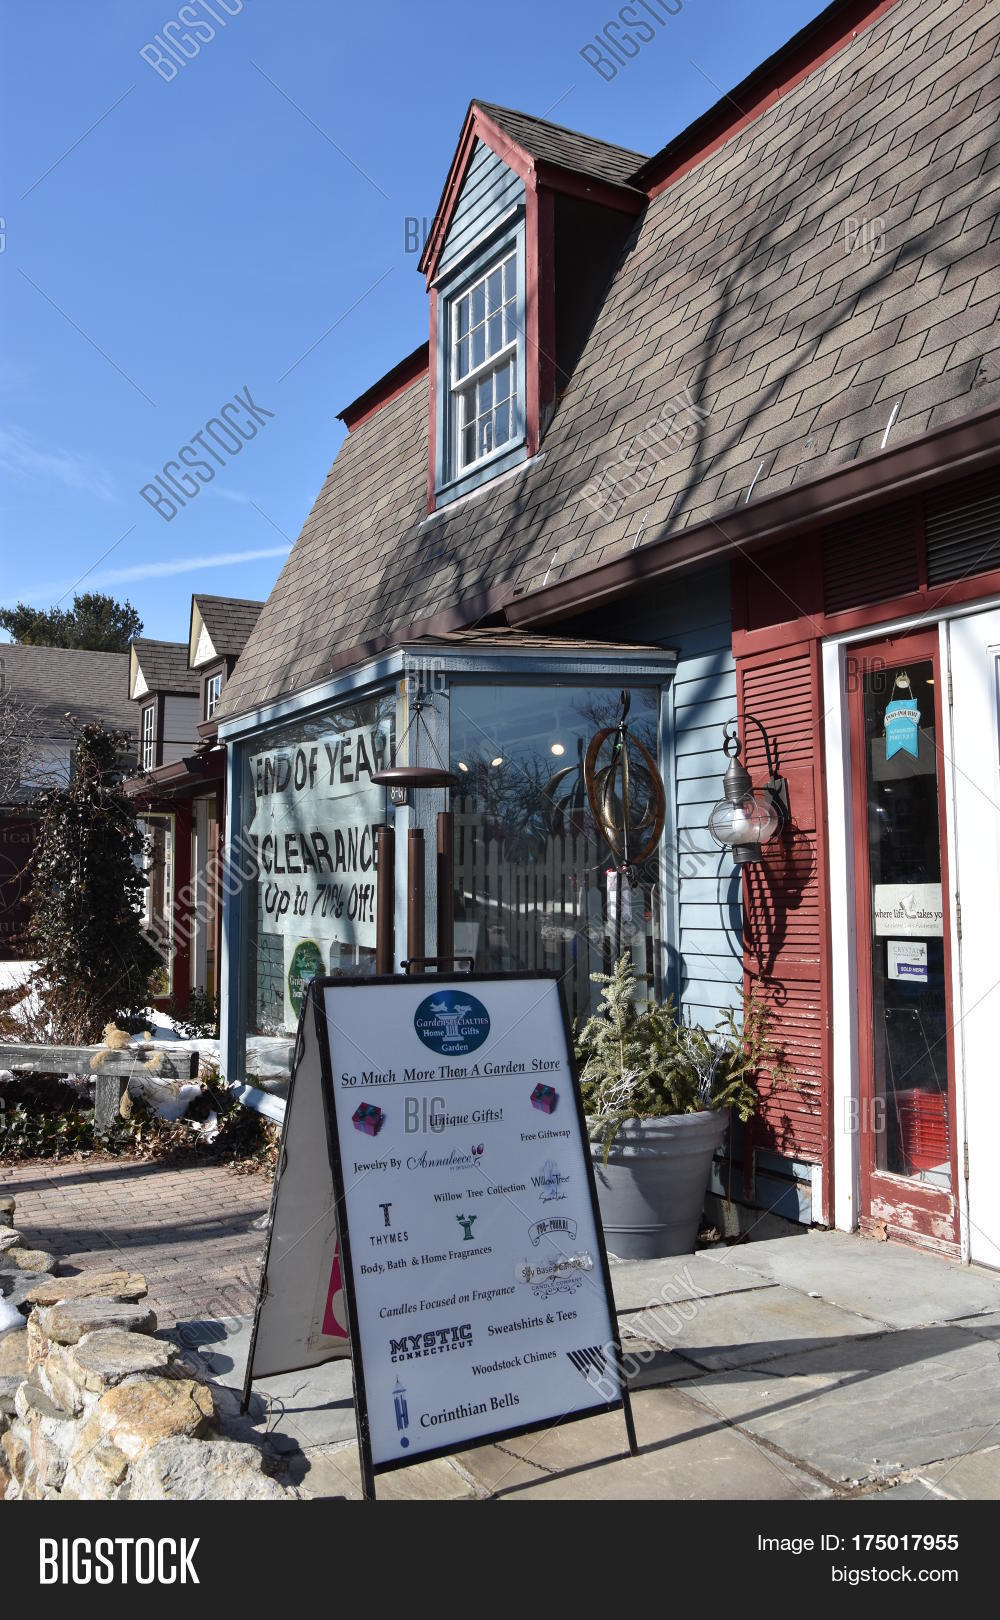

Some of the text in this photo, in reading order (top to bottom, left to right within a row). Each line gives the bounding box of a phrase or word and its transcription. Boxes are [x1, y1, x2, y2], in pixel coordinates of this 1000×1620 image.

[256, 753, 291, 798] END
[294, 747, 318, 791] OF
[261, 823, 385, 875] CLEARANCE
[264, 882, 375, 922] Up to 70% Off!
[423, 1027, 480, 1037] Home Gifts
[441, 1043, 469, 1052] Garden
[341, 1072, 357, 1086] So
[361, 1070, 396, 1085] Much
[403, 1067, 435, 1082] More
[470, 1063, 481, 1076] A
[484, 1060, 525, 1075] Garden
[531, 1058, 561, 1071] Store
[430, 1108, 503, 1128] Unique Gifts!
[520, 1128, 571, 1143] Free Giftwrap
[354, 1159, 388, 1174] Jewelry
[390, 1158, 402, 1170] By
[433, 1182, 526, 1203] Willow Tree Collection
[370, 1231, 409, 1246] THYMES
[360, 1246, 493, 1275] Body, Bath & Home Fragrances
[379, 1285, 516, 1319] Candles Focused on Fragrance
[487, 1309, 578, 1337] Sweatshirts & Tees
[389, 1323, 473, 1355] MYSTIC
[391, 1339, 474, 1363] CONNECTICUT
[472, 1350, 557, 1376] Woodstock Chimes
[420, 1392, 520, 1428] Corinthian Bells
